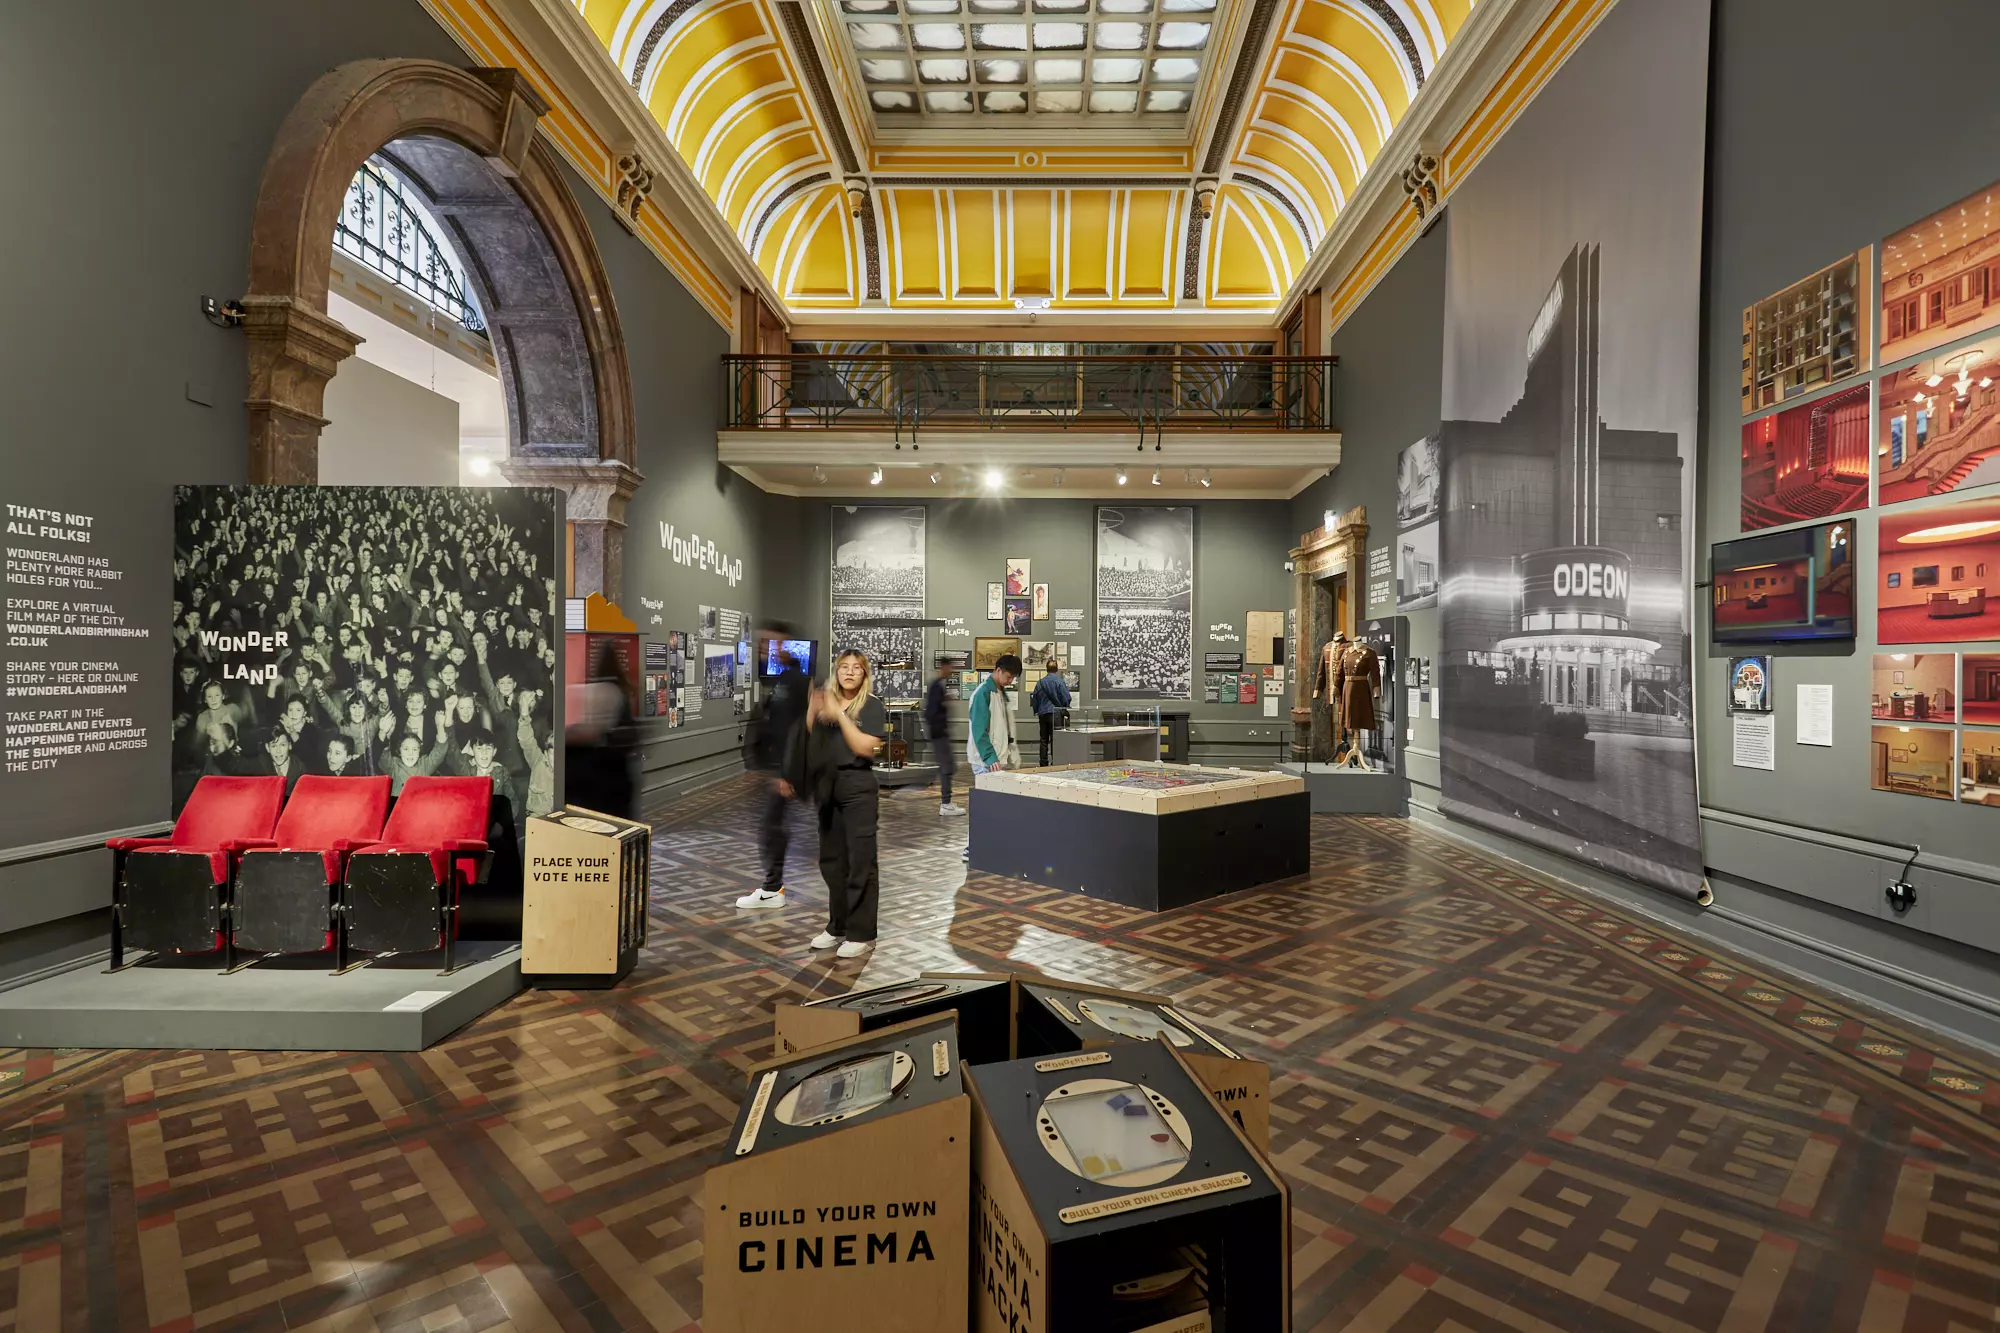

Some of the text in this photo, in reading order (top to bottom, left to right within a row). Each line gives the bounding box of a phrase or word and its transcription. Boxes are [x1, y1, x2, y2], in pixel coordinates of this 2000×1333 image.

[7, 504, 93, 528] THAT'S NOT
[7, 522, 90, 543] ALL FOLKS!
[7, 548, 108, 567] WONDERLAND HAS
[660, 521, 742, 587] WONDERLAND
[7, 561, 123, 580] PLENTY MORE RABBIT
[7, 573, 102, 590] HOLES FOR YOU...
[1554, 563, 1628, 600] ODEON
[7, 598, 115, 614] EXPLORE A VIRTUAL
[7, 611, 124, 626] FILM MAP OF THE CITY
[1211, 623, 1232, 631] SUPER
[7, 624, 149, 638] WONDERLANDBIRMINGHAM
[940, 628, 969, 636] PALACES
[7, 636, 48, 647] .CO.UK
[201, 630, 288, 653] WONDER
[7, 662, 119, 672] SHARE YOUR CINEMA
[224, 664, 278, 685] LAND
[7, 674, 45, 684] STORY
[58, 674, 86, 683] HERE
[88, 673, 102, 682] OR
[105, 673, 138, 682] ONLINE
[7, 684, 127, 696] #WONDERLANDBHAM
[7, 708, 104, 722] TAKE PART IN THE
[6, 718, 132, 735] WONDERLAND EVENTS
[6, 728, 146, 747] HAPPENING THROUGHOUT
[6, 739, 147, 760] THE SUMMER AND ACROSS
[6, 759, 58, 772] THE CITY
[533, 858, 609, 867] PLACE YOUR
[534, 872, 610, 882] VOTE HERE
[1042, 1054, 1104, 1069] WONDERLAND
[1069, 1176, 1243, 1220] BUILD YOUR OWN CINEMA SNACKS
[739, 1200, 937, 1227] BUILD YOUR OWN
[989, 1195, 1009, 1238] YOUR
[1013, 1231, 1032, 1274] OWN
[738, 1229, 936, 1274] CINEMA
